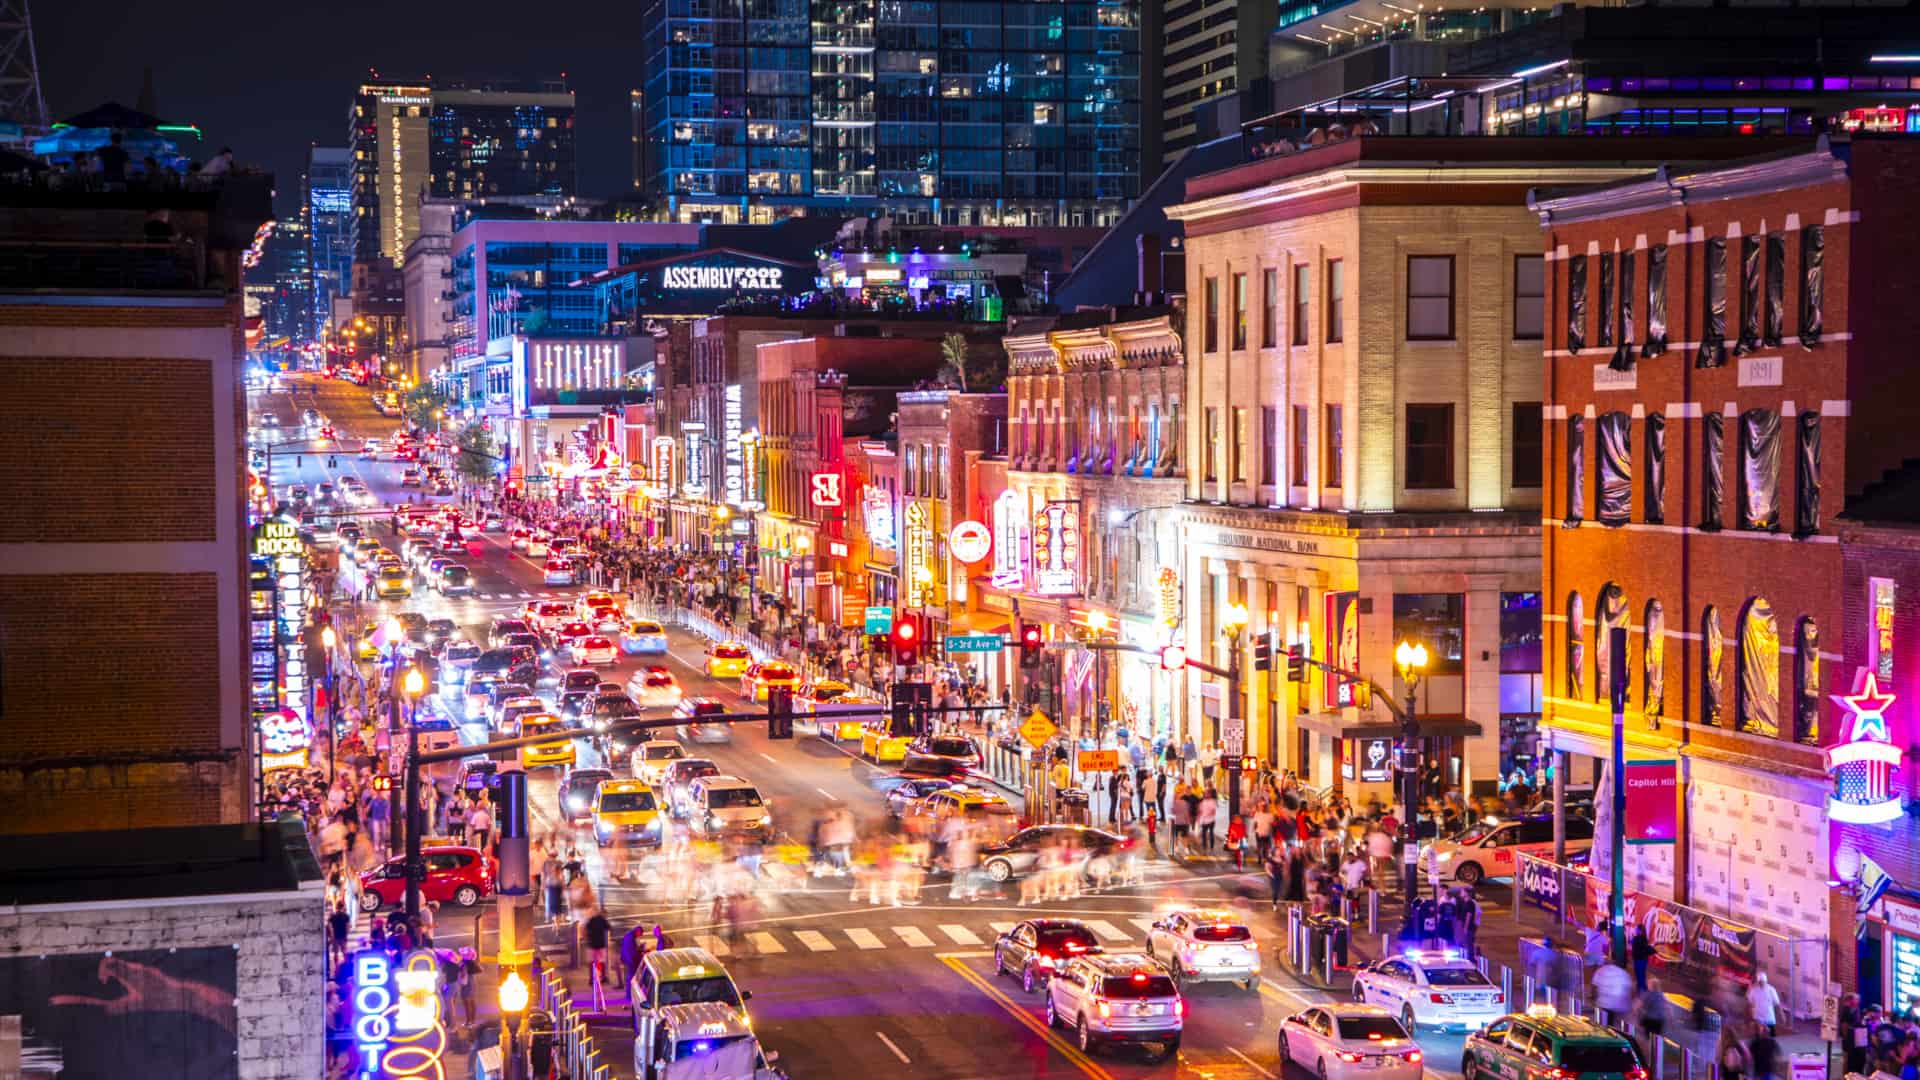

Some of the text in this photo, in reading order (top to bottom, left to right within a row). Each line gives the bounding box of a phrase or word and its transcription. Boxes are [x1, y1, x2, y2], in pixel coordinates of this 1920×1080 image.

[663, 267, 733, 289] ASSEMBLY
[734, 267, 782, 279] FOOD
[726, 384, 742, 459] WHISKEY
[266, 524, 296, 538] KID
[1628, 778, 1658, 788] Capitol
[356, 957, 390, 1080] BOOT
